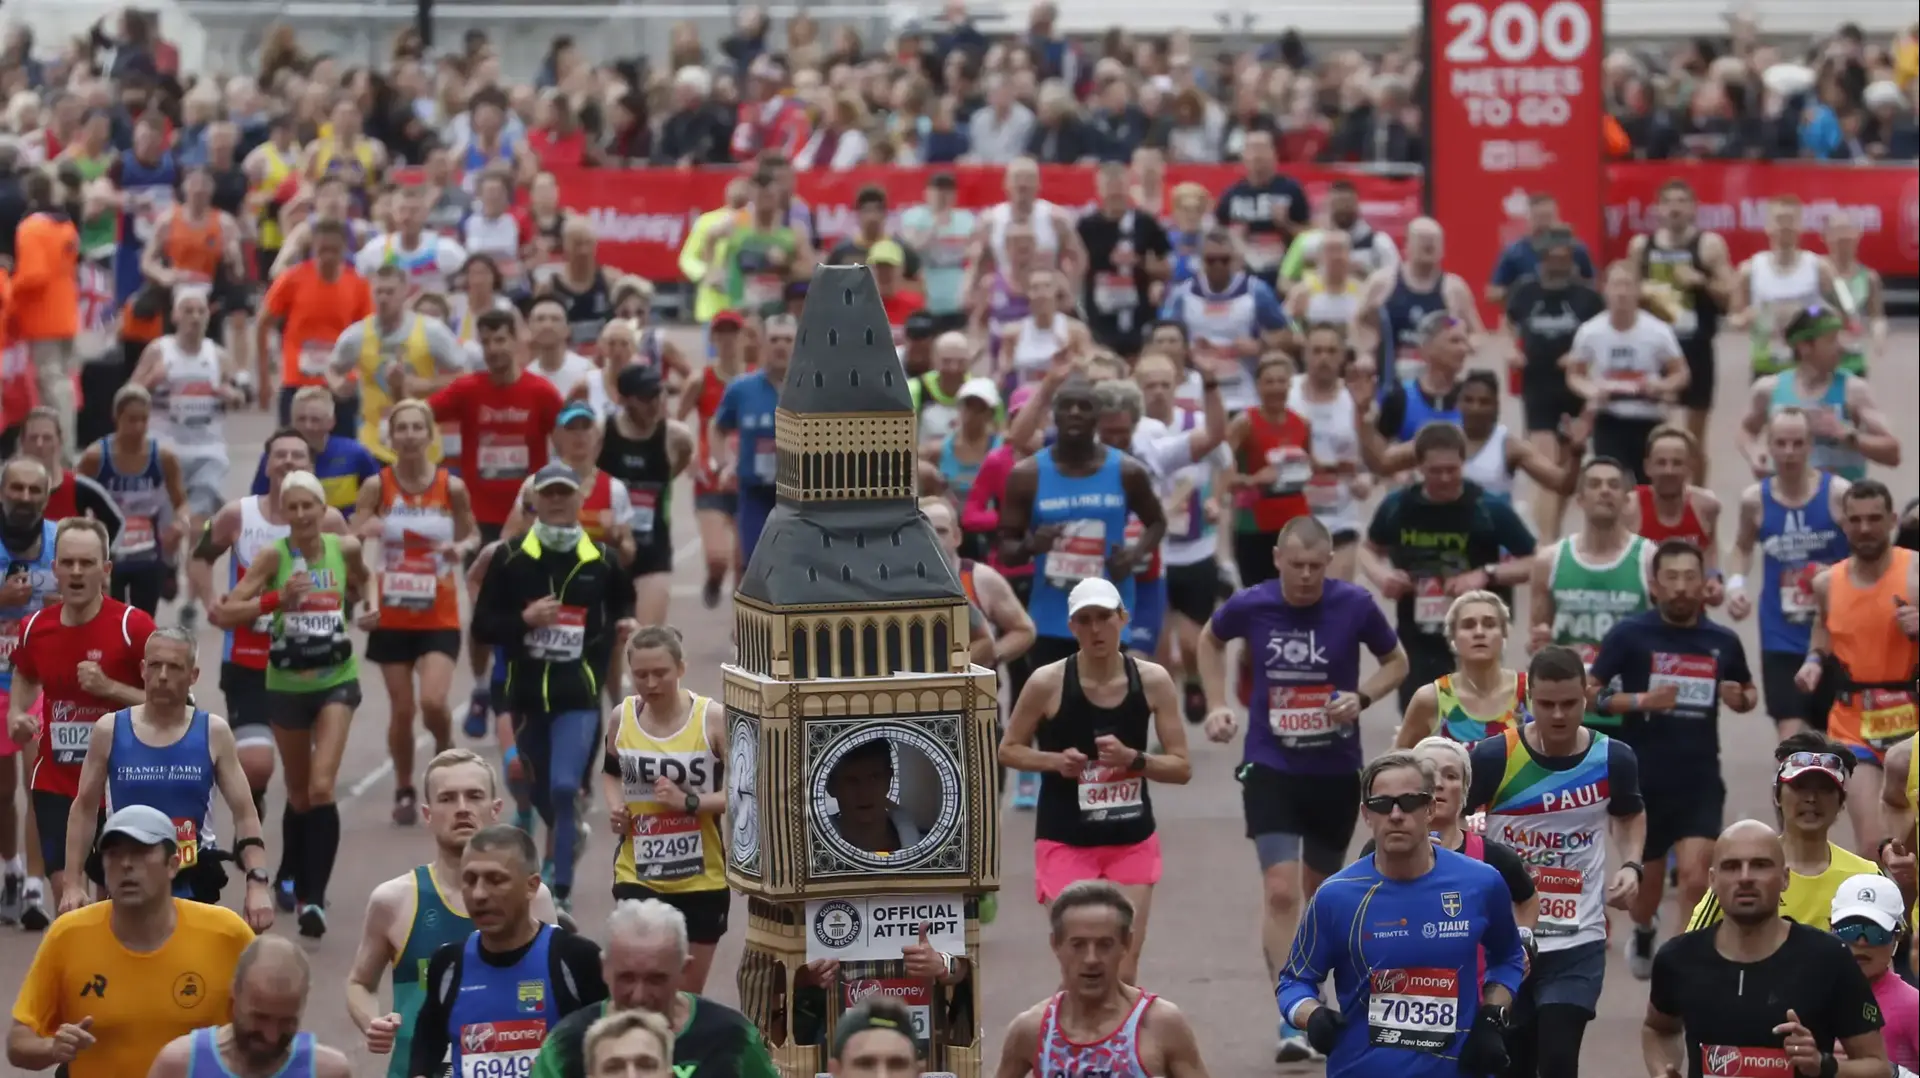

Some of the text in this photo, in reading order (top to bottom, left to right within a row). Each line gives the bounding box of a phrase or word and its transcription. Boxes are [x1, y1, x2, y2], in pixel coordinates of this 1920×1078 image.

[1444, 1, 1591, 62] 200
[1450, 66, 1583, 96] METRES
[1464, 95, 1571, 127] TO GO
[1784, 510, 1813, 533] AL
[1401, 528, 1469, 556] Harry
[1280, 712, 1331, 731] 40851
[58, 726, 94, 746] 602
[118, 765, 202, 774] GRANGE FARM
[125, 773, 165, 781] Dunmow
[168, 773, 202, 781] Runners
[1086, 782, 1139, 805] 34707
[1542, 783, 1604, 812] PAUL
[642, 835, 700, 860] 32497
[1503, 825, 1594, 849] RAINBOW
[1542, 874, 1580, 888] money
[819, 903, 855, 917] GUINNESS
[873, 904, 958, 922] OFFICIAL
[1539, 898, 1577, 919] 368
[816, 921, 860, 947] WORLD RECORDS
[1373, 929, 1410, 939] TRIMTEX
[1438, 920, 1470, 932] TJALVE
[850, 980, 925, 1002] Virgin money
[1376, 969, 1455, 992] Virgin money
[1380, 999, 1455, 1027] 70358
[498, 1029, 543, 1042] money
[1400, 1038, 1416, 1047] new
[474, 1056, 532, 1078] 6949
[1708, 1045, 1792, 1075] Virgin money
